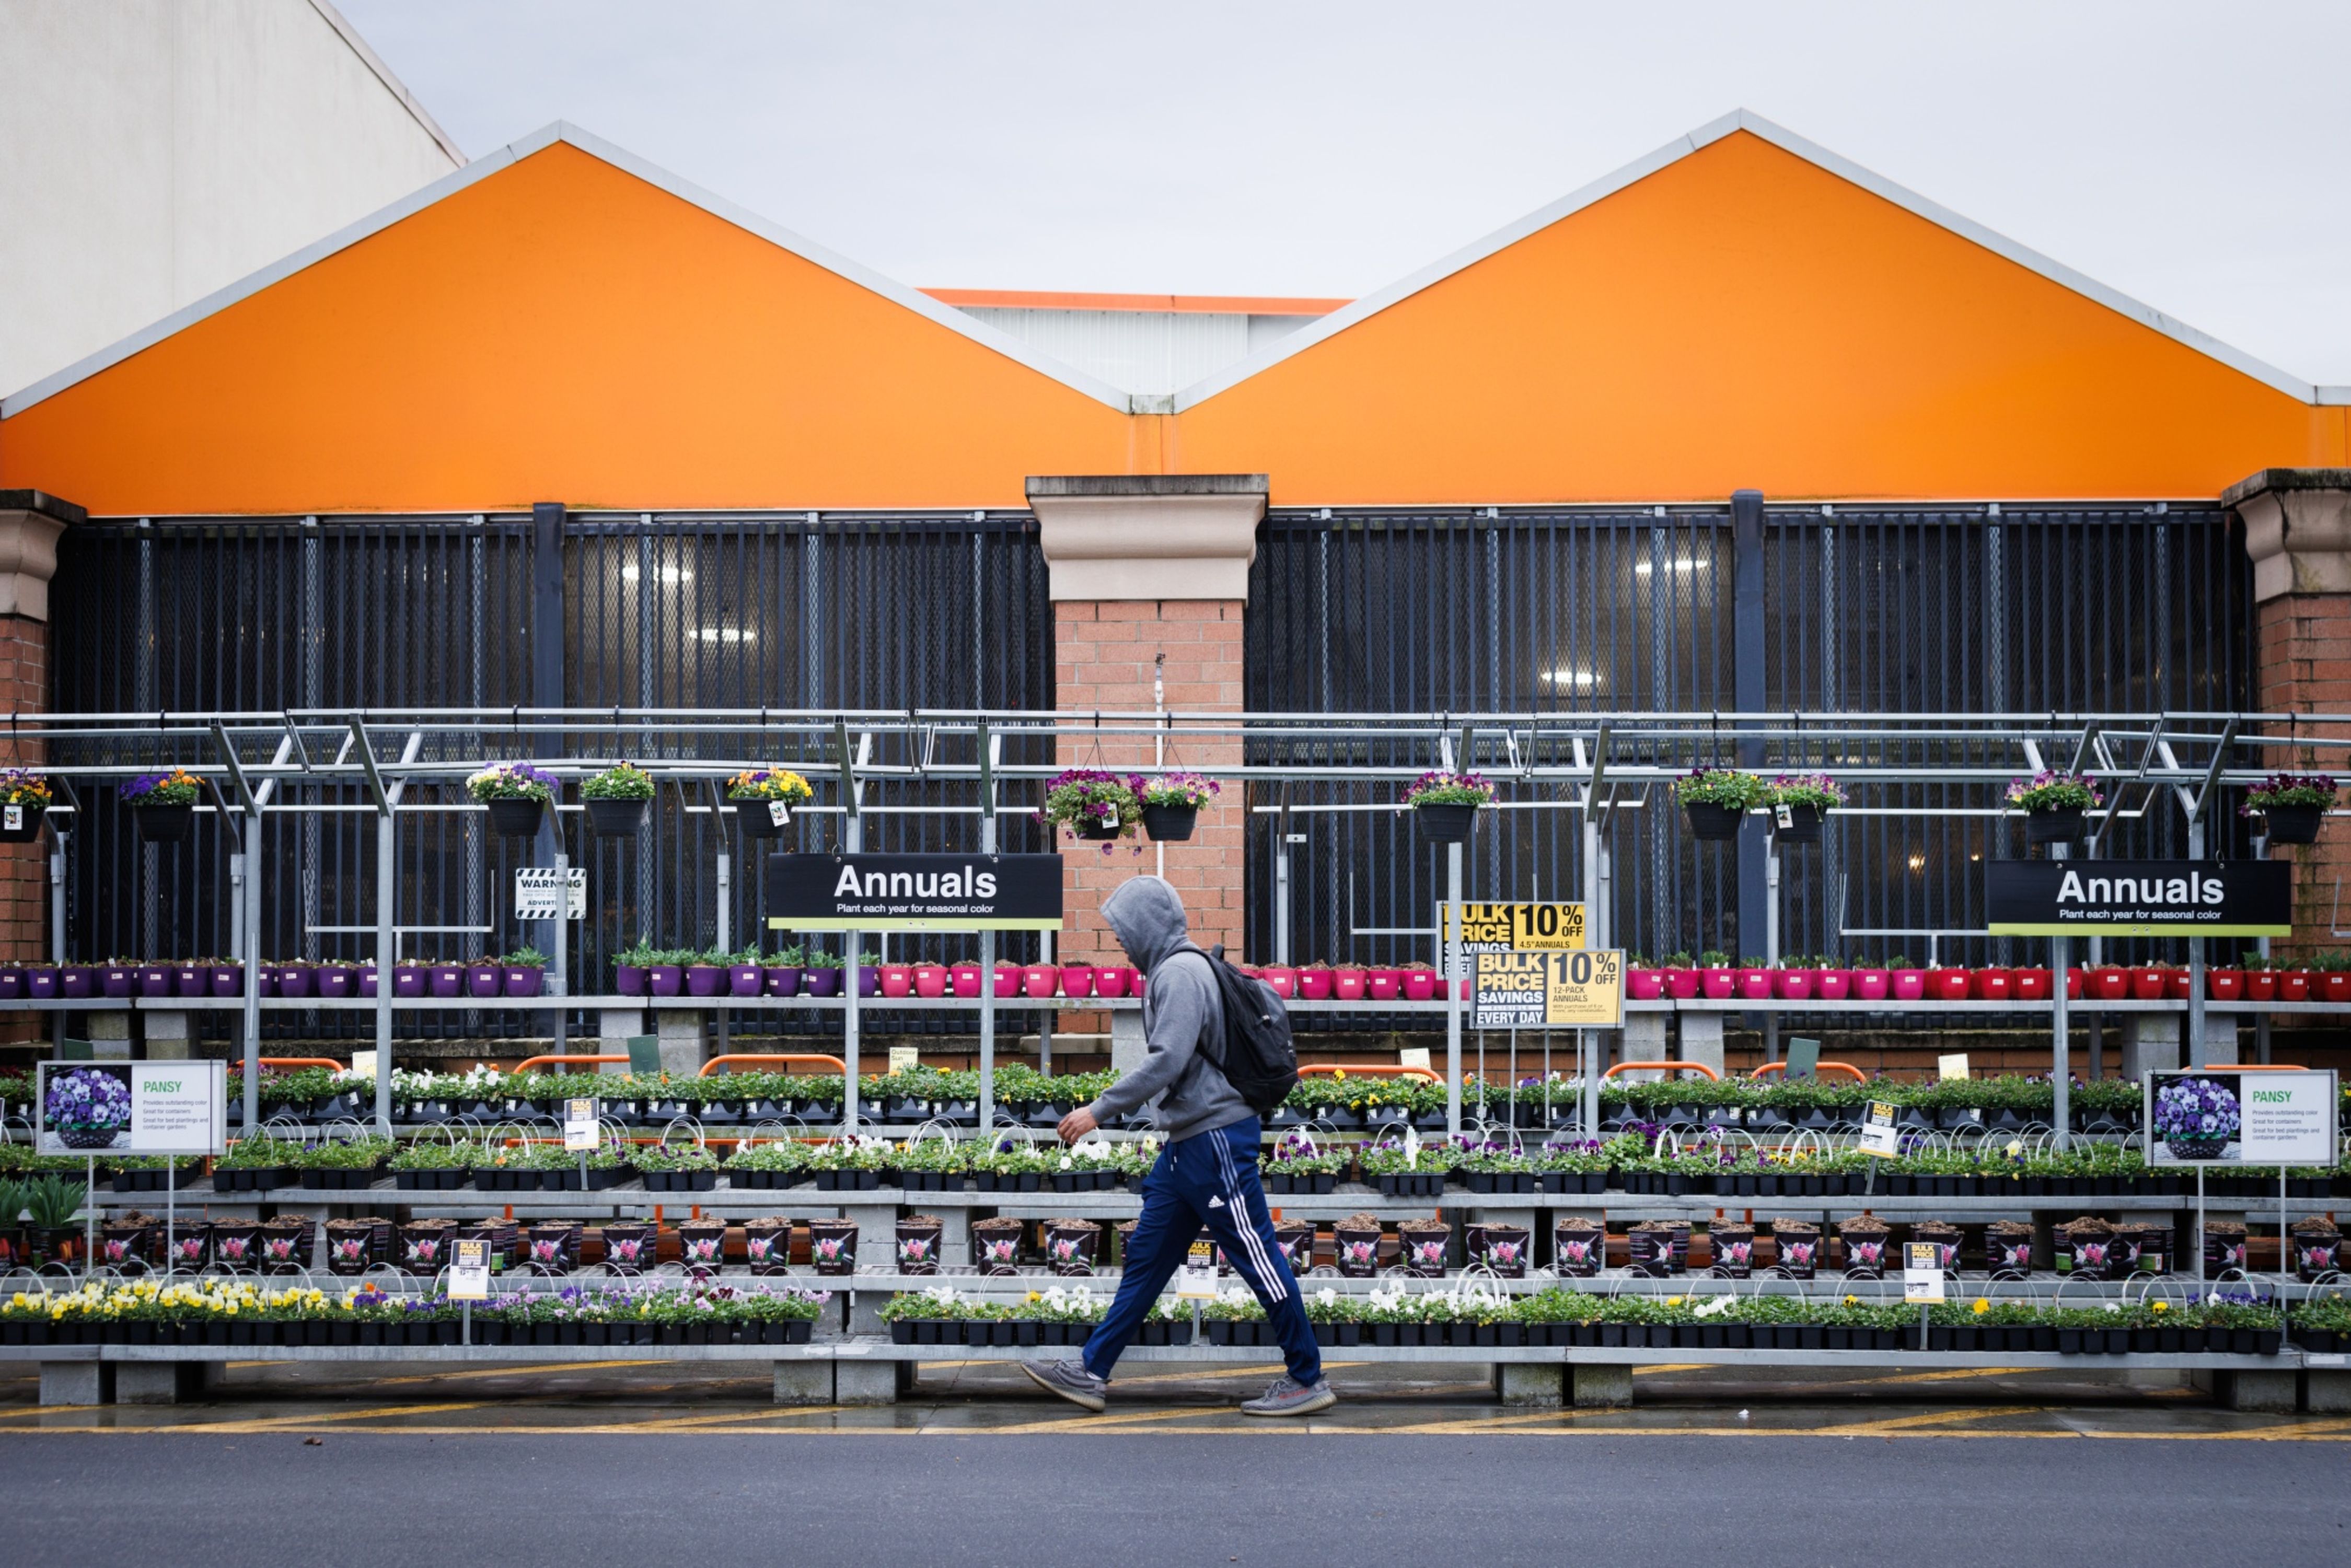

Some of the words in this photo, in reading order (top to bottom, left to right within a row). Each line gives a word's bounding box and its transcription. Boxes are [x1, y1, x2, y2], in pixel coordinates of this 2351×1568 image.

[521, 879, 582, 888] WARNNG
[834, 865, 997, 898] Annuals
[2056, 870, 2224, 904] Annuals
[837, 904, 861, 913] Plant
[863, 904, 886, 913] each
[888, 906, 909, 915] year
[911, 904, 924, 913] for
[926, 904, 968, 913] seasonal
[970, 904, 994, 913] color
[2059, 909, 2084, 919] Plant
[2087, 910, 2110, 919] each
[2112, 912, 2134, 921] year
[2136, 910, 2149, 919] for
[2151, 911, 2194, 919] seasonal
[2196, 910, 2221, 919] color
[1520, 905, 1558, 936] 10
[1562, 905, 1582, 925] %
[1562, 926, 1583, 937] OFF
[1478, 954, 1544, 972] BULK
[1554, 953, 1592, 985] 10
[1596, 954, 1616, 973] %
[1478, 973, 1544, 991] PRICE
[1595, 974, 1616, 985] OFF
[1477, 991, 1544, 1004] SAVINGS
[1477, 1012, 1516, 1024] EVERY
[1520, 1012, 1544, 1024] DAY
[144, 1081, 182, 1093] PANSY
[2253, 1090, 2292, 1103] PANSY
